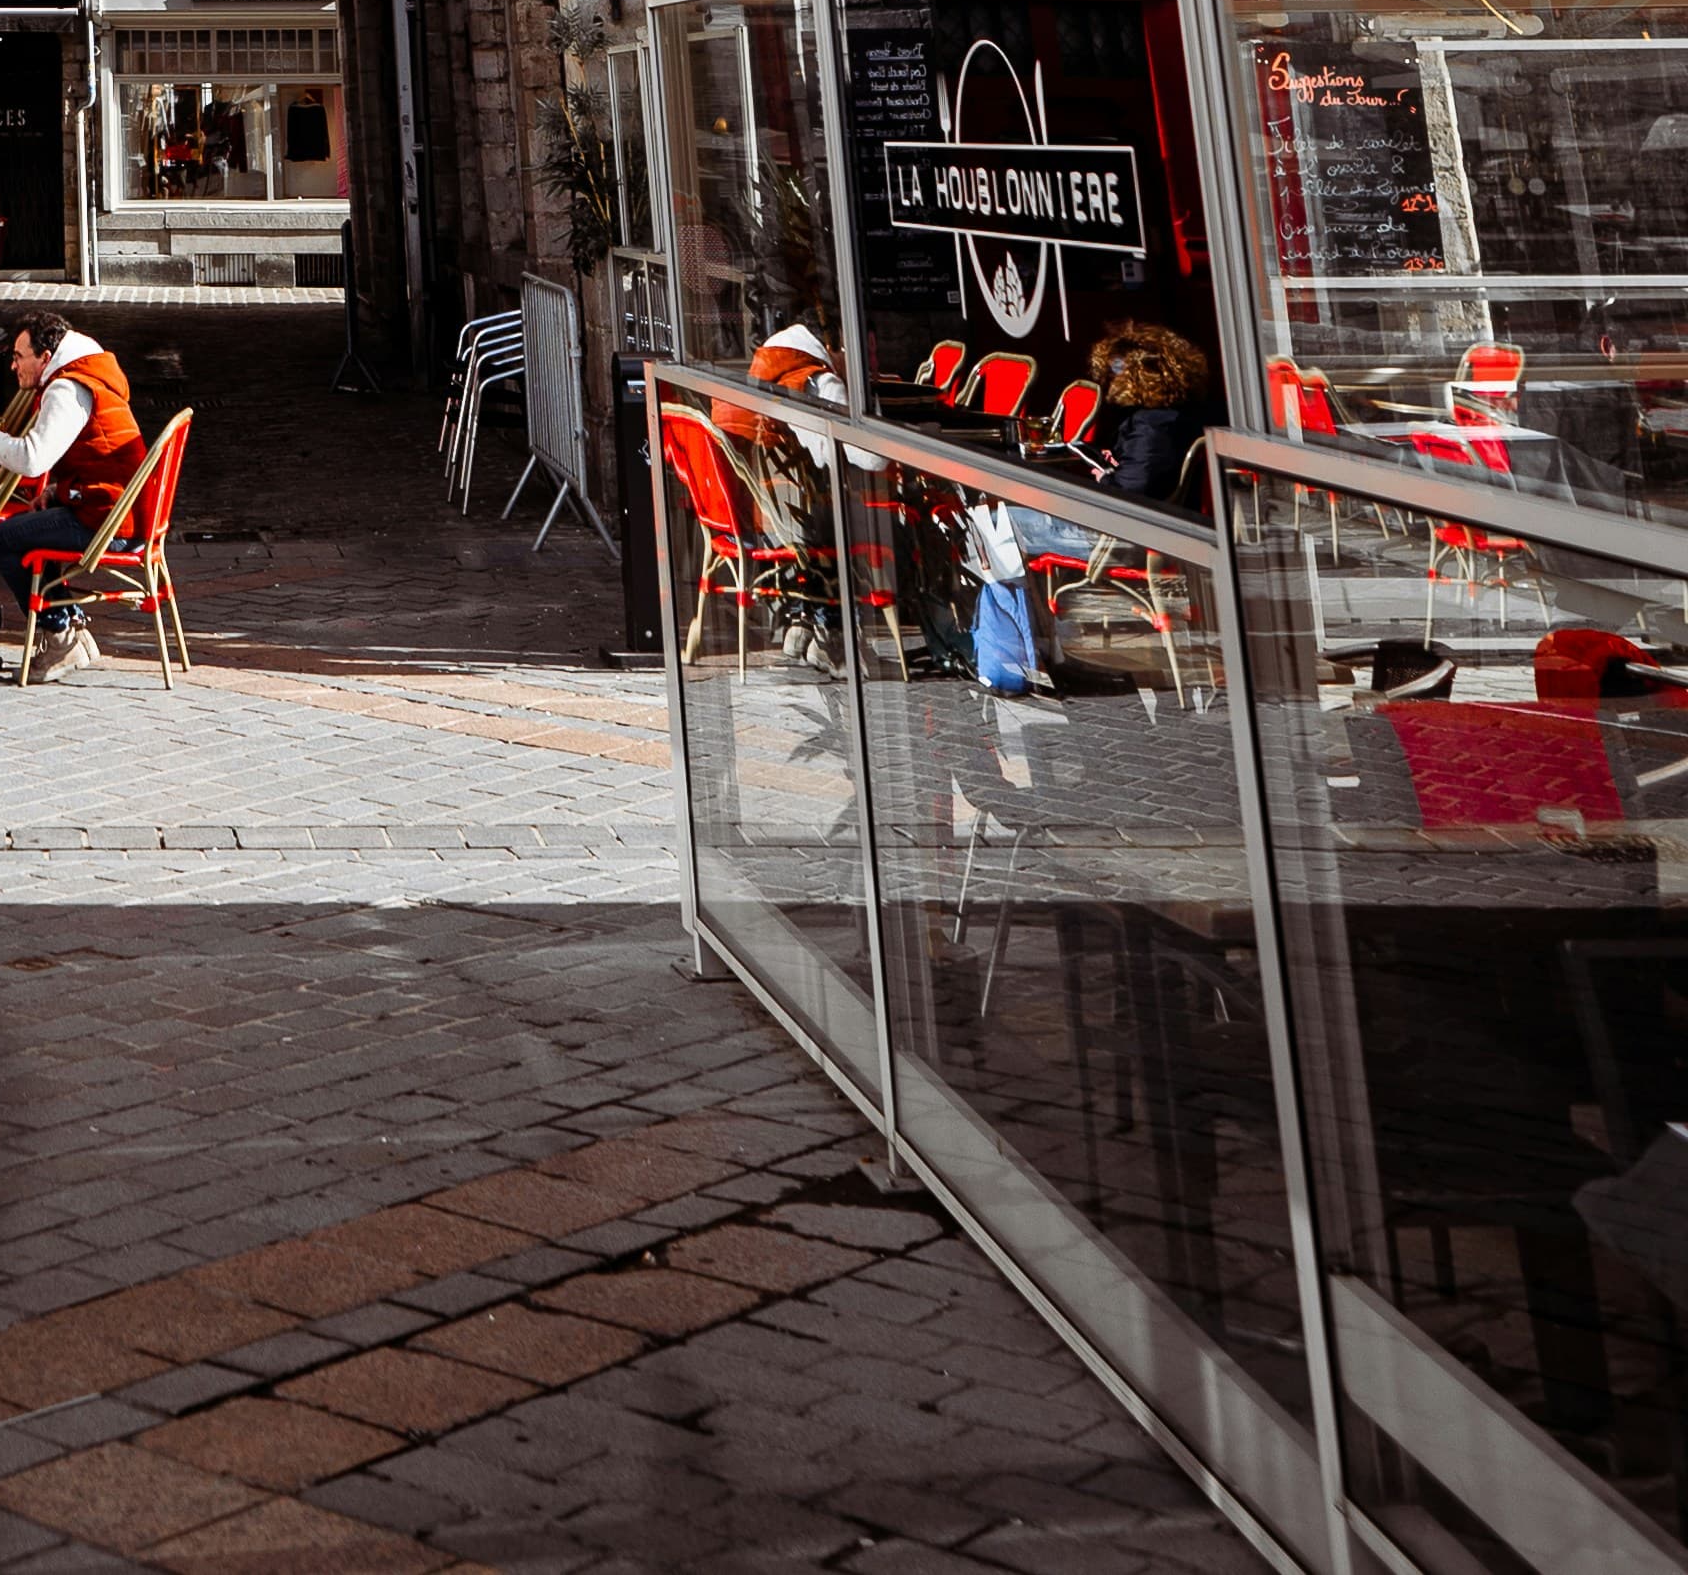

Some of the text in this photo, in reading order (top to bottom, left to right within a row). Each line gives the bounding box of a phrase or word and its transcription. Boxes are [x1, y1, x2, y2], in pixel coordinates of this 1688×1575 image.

[1268, 52, 1365, 105] Suggestions
[1319, 90, 1344, 106] du
[898, 165, 1124, 226] LA HOUBLONNIERE
